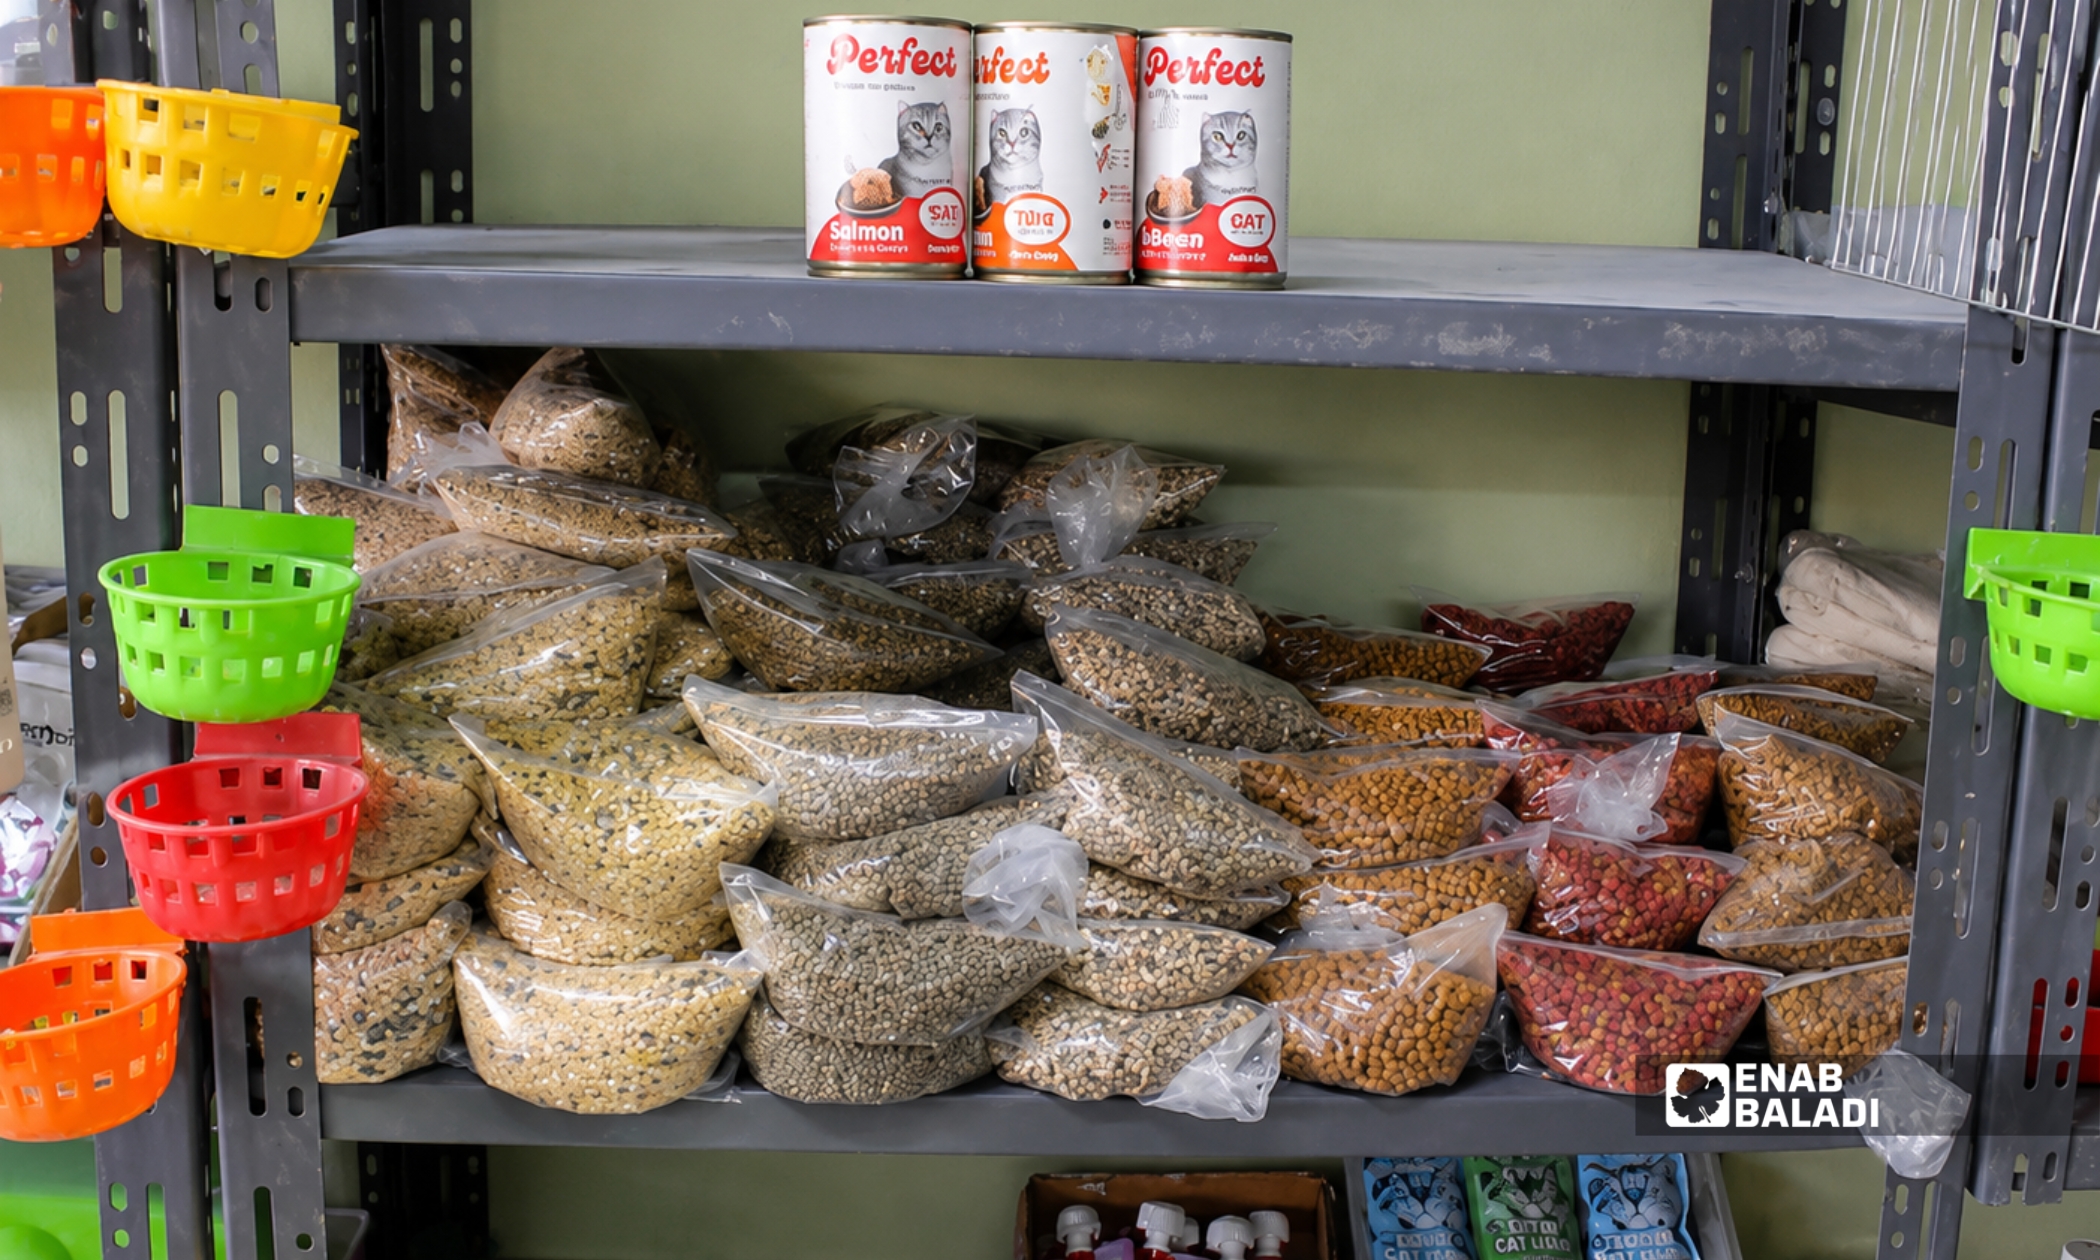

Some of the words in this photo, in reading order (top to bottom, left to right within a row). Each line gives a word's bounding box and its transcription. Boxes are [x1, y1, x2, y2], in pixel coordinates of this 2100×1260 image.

[826, 33, 957, 78] Perfect
[1144, 46, 1265, 87] Perfect
[830, 220, 904, 241] Salmon
